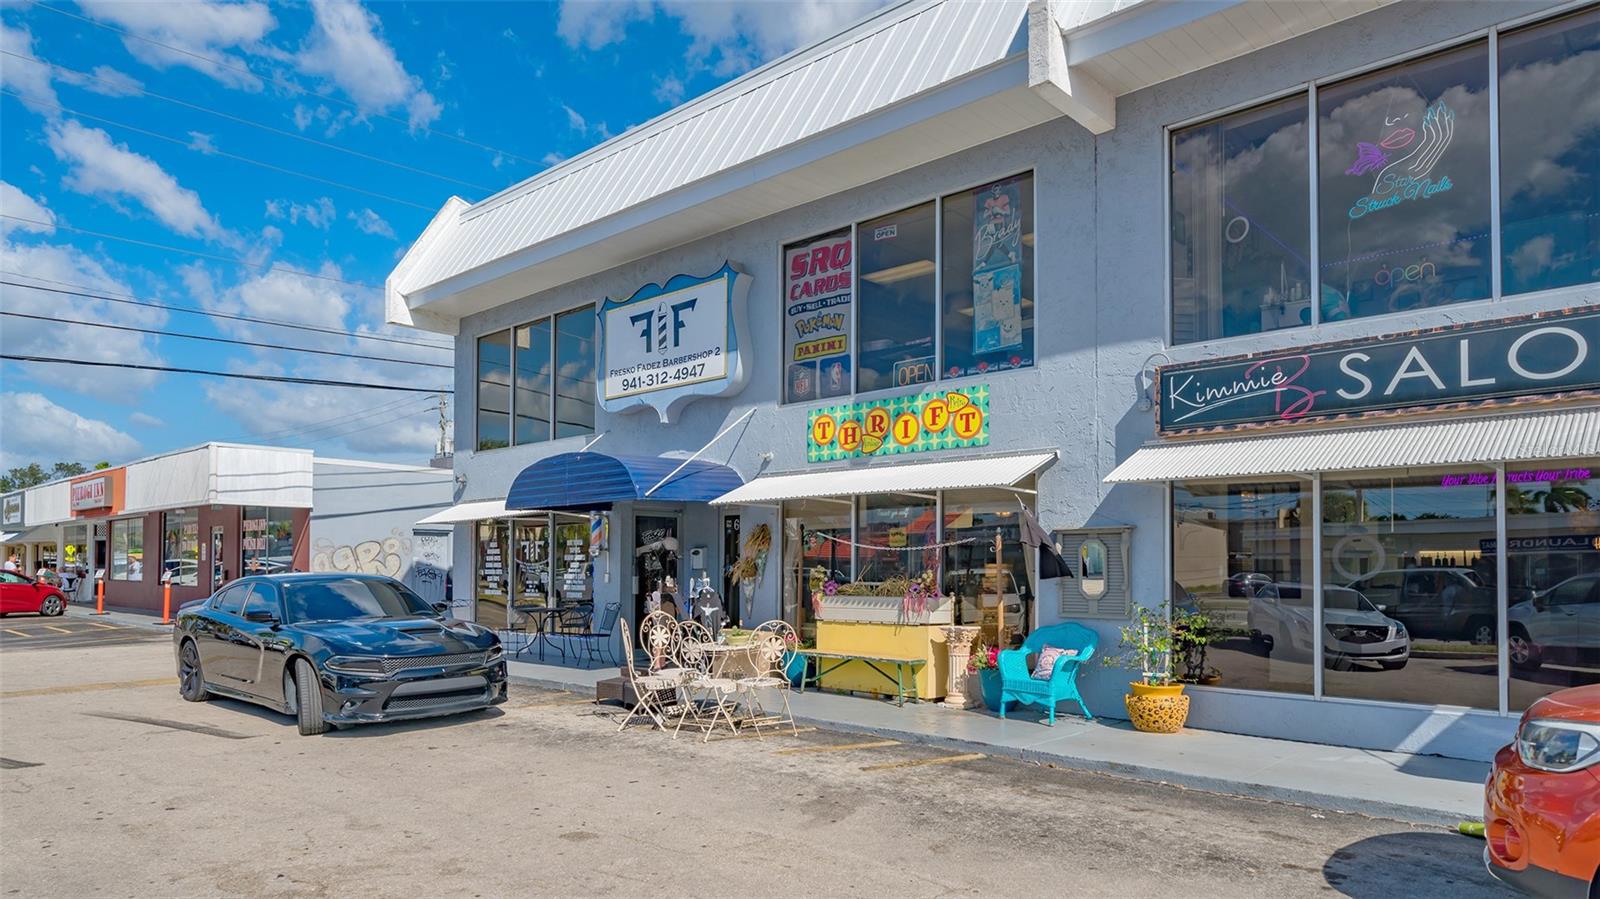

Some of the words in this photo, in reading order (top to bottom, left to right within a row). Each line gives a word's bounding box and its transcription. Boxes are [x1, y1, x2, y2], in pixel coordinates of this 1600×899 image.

[1376, 173, 1414, 195] Star
[1349, 194, 1401, 219] Struck
[1404, 176, 1453, 201] Nails
[876, 229, 896, 239] OPEN
[790, 272, 851, 301] CARDS
[662, 349, 713, 367] BARBERSHOP
[714, 347, 721, 356] 2
[797, 339, 844, 357] PANINI
[622, 364, 706, 391] 941-312-4947
[898, 363, 934, 386] OPEN
[1169, 367, 1287, 411] Kimmie
[818, 406, 976, 445] THRIFT
